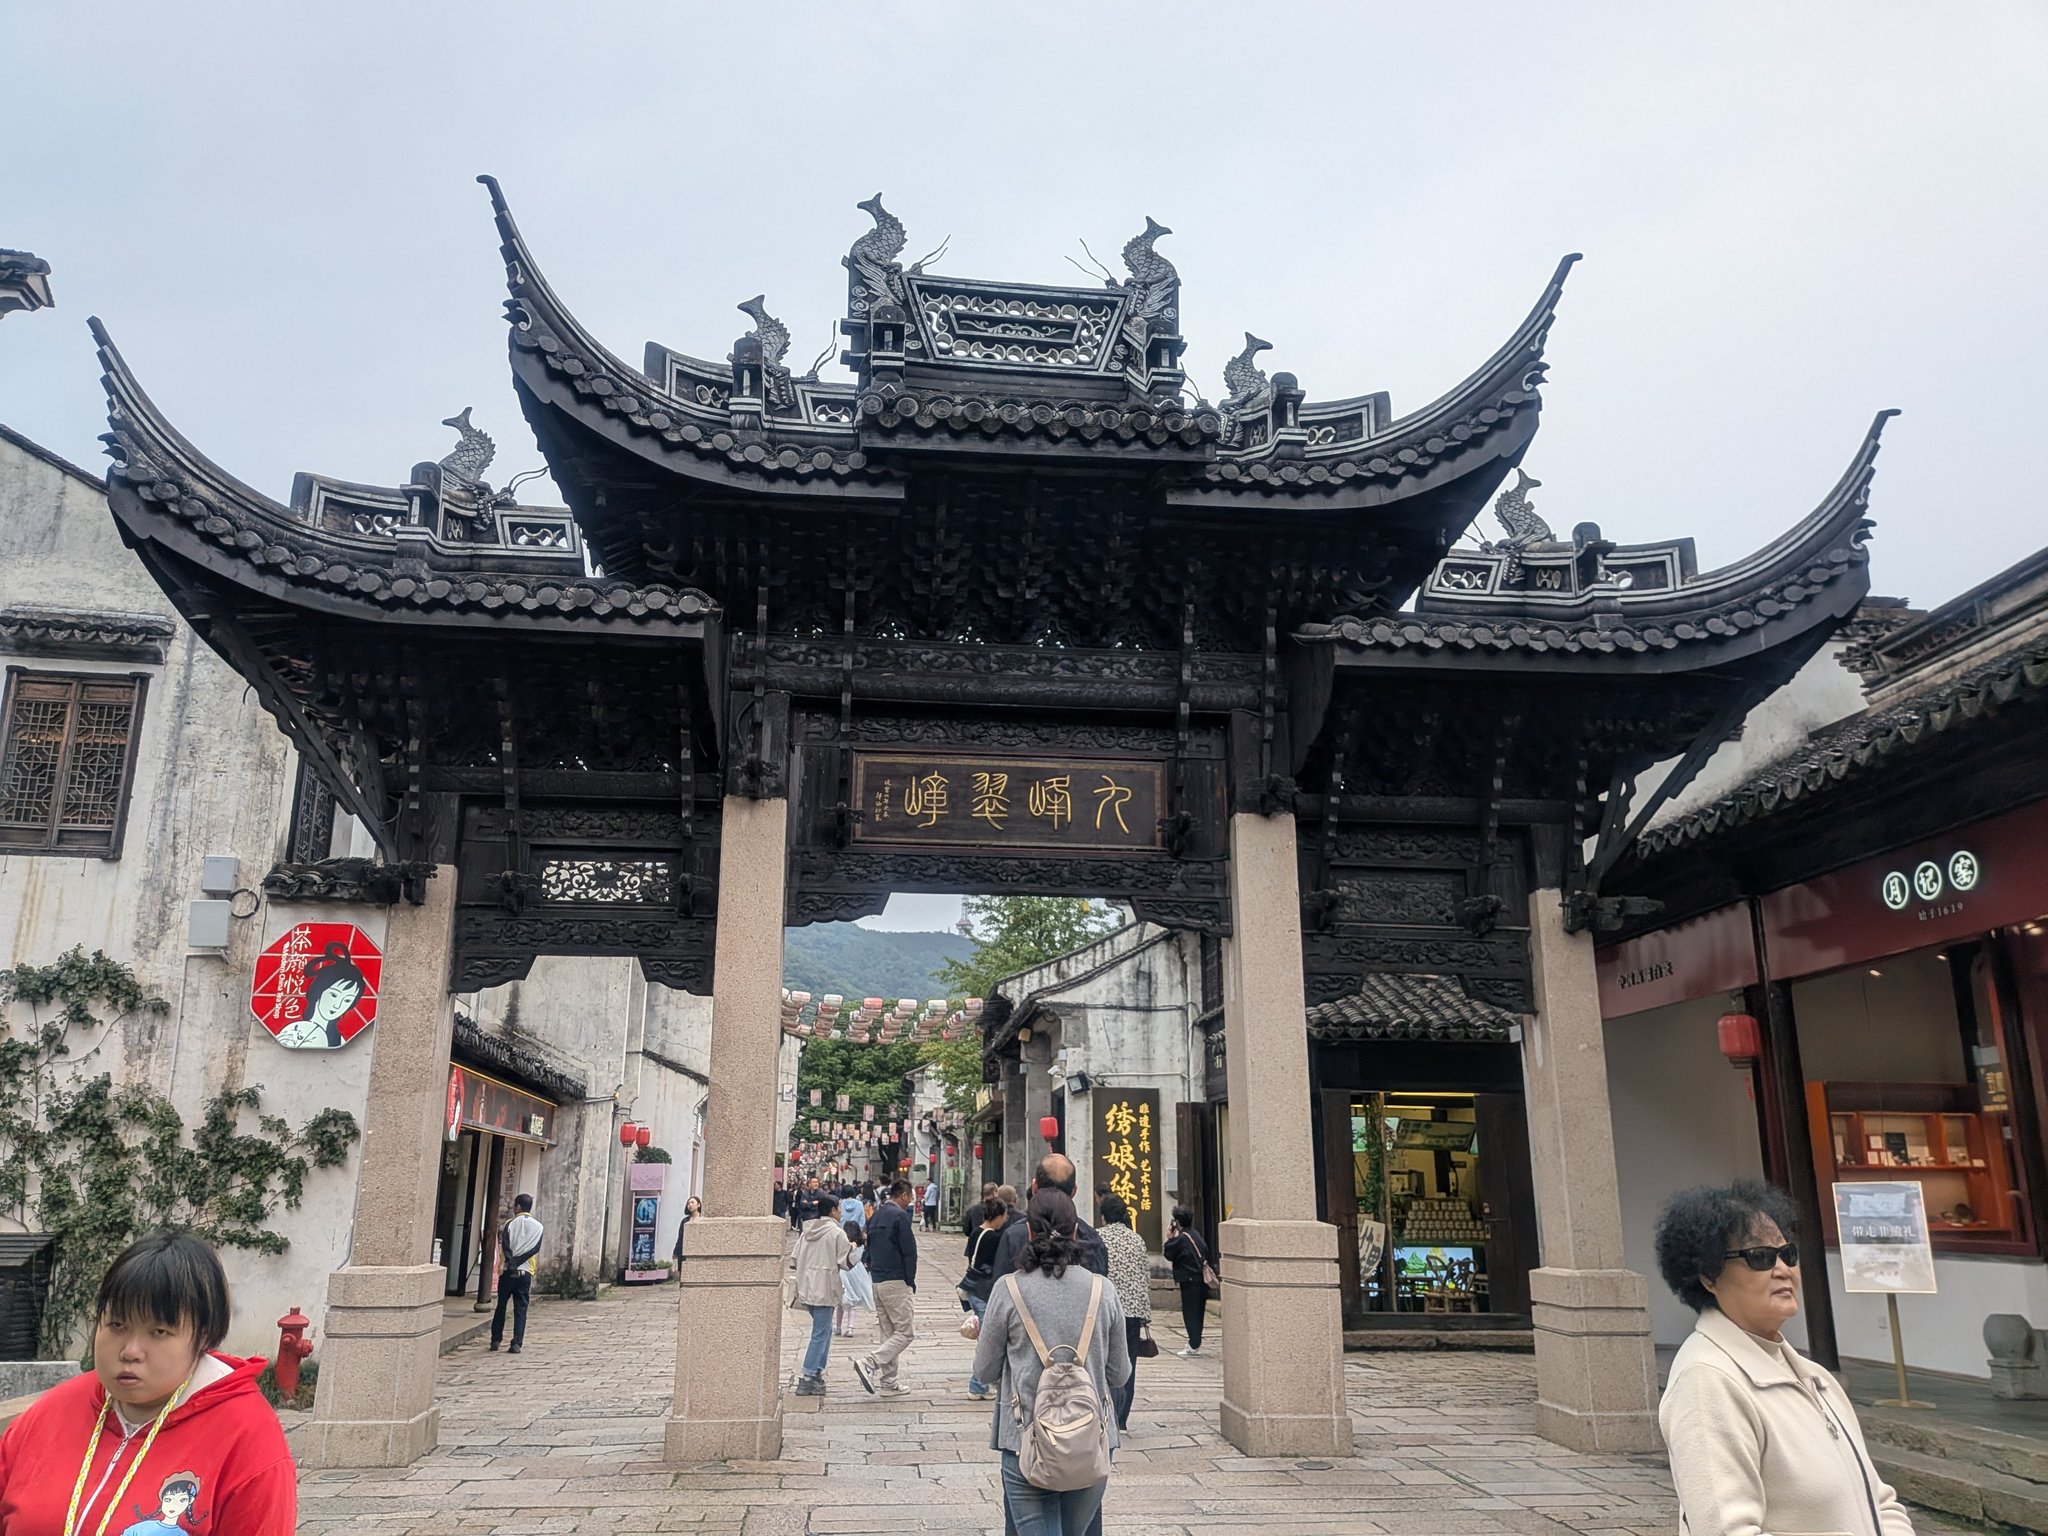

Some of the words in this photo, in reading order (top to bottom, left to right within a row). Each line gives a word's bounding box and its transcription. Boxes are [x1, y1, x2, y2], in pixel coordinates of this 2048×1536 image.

[1884, 851, 1978, 909] 月记窑
[284, 926, 312, 1019] 茶颜悦色
[277, 973, 286, 991] China
[275, 991, 284, 1003] Tea
[273, 1002, 282, 1019] Shop
[1852, 1224, 1916, 1239] 带走非遗礼
